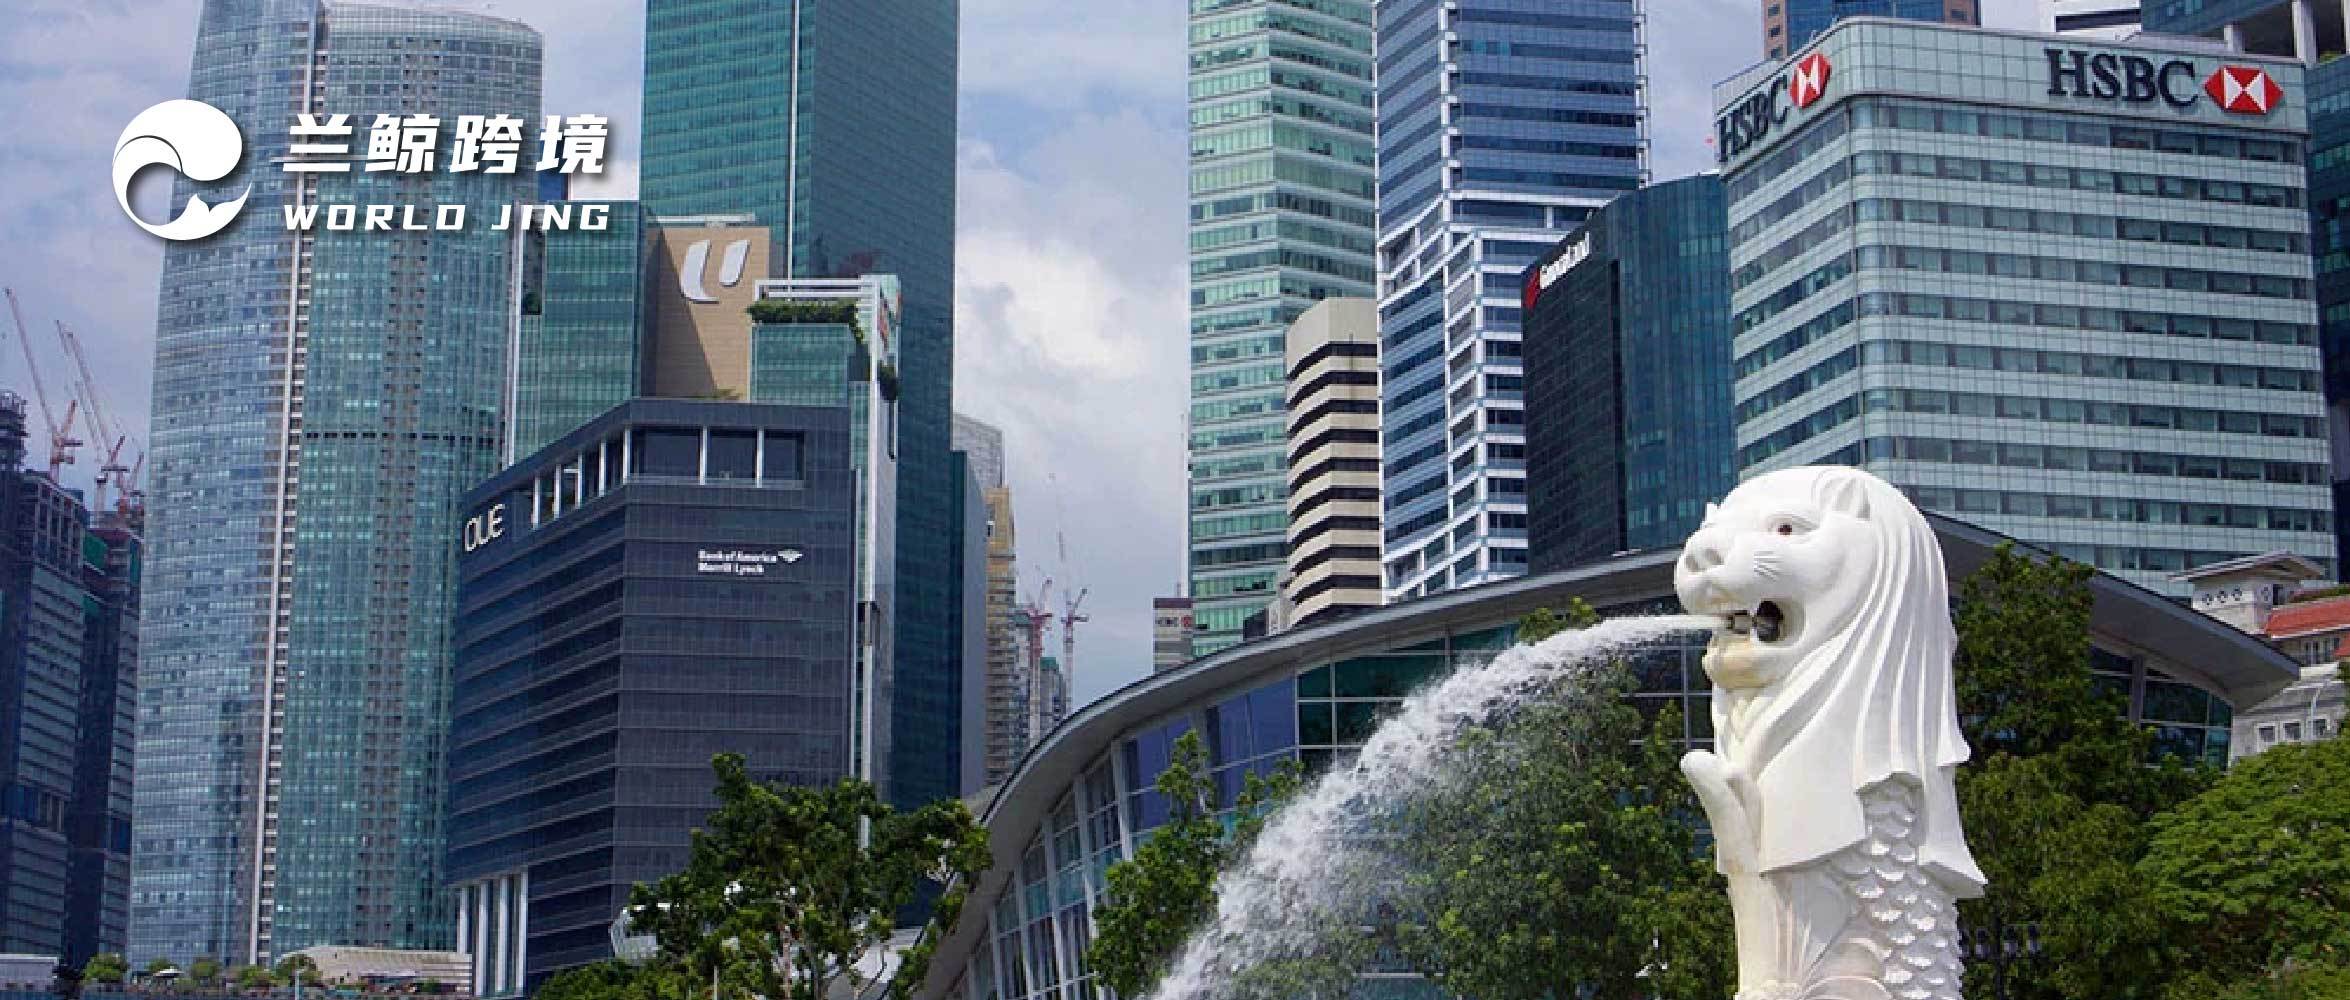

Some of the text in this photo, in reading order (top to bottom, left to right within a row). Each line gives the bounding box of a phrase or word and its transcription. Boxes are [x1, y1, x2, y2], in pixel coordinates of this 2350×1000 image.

[2044, 48, 2198, 107] HSBC
[1719, 74, 1788, 162] HSBC
[465, 503, 506, 551] OUE
